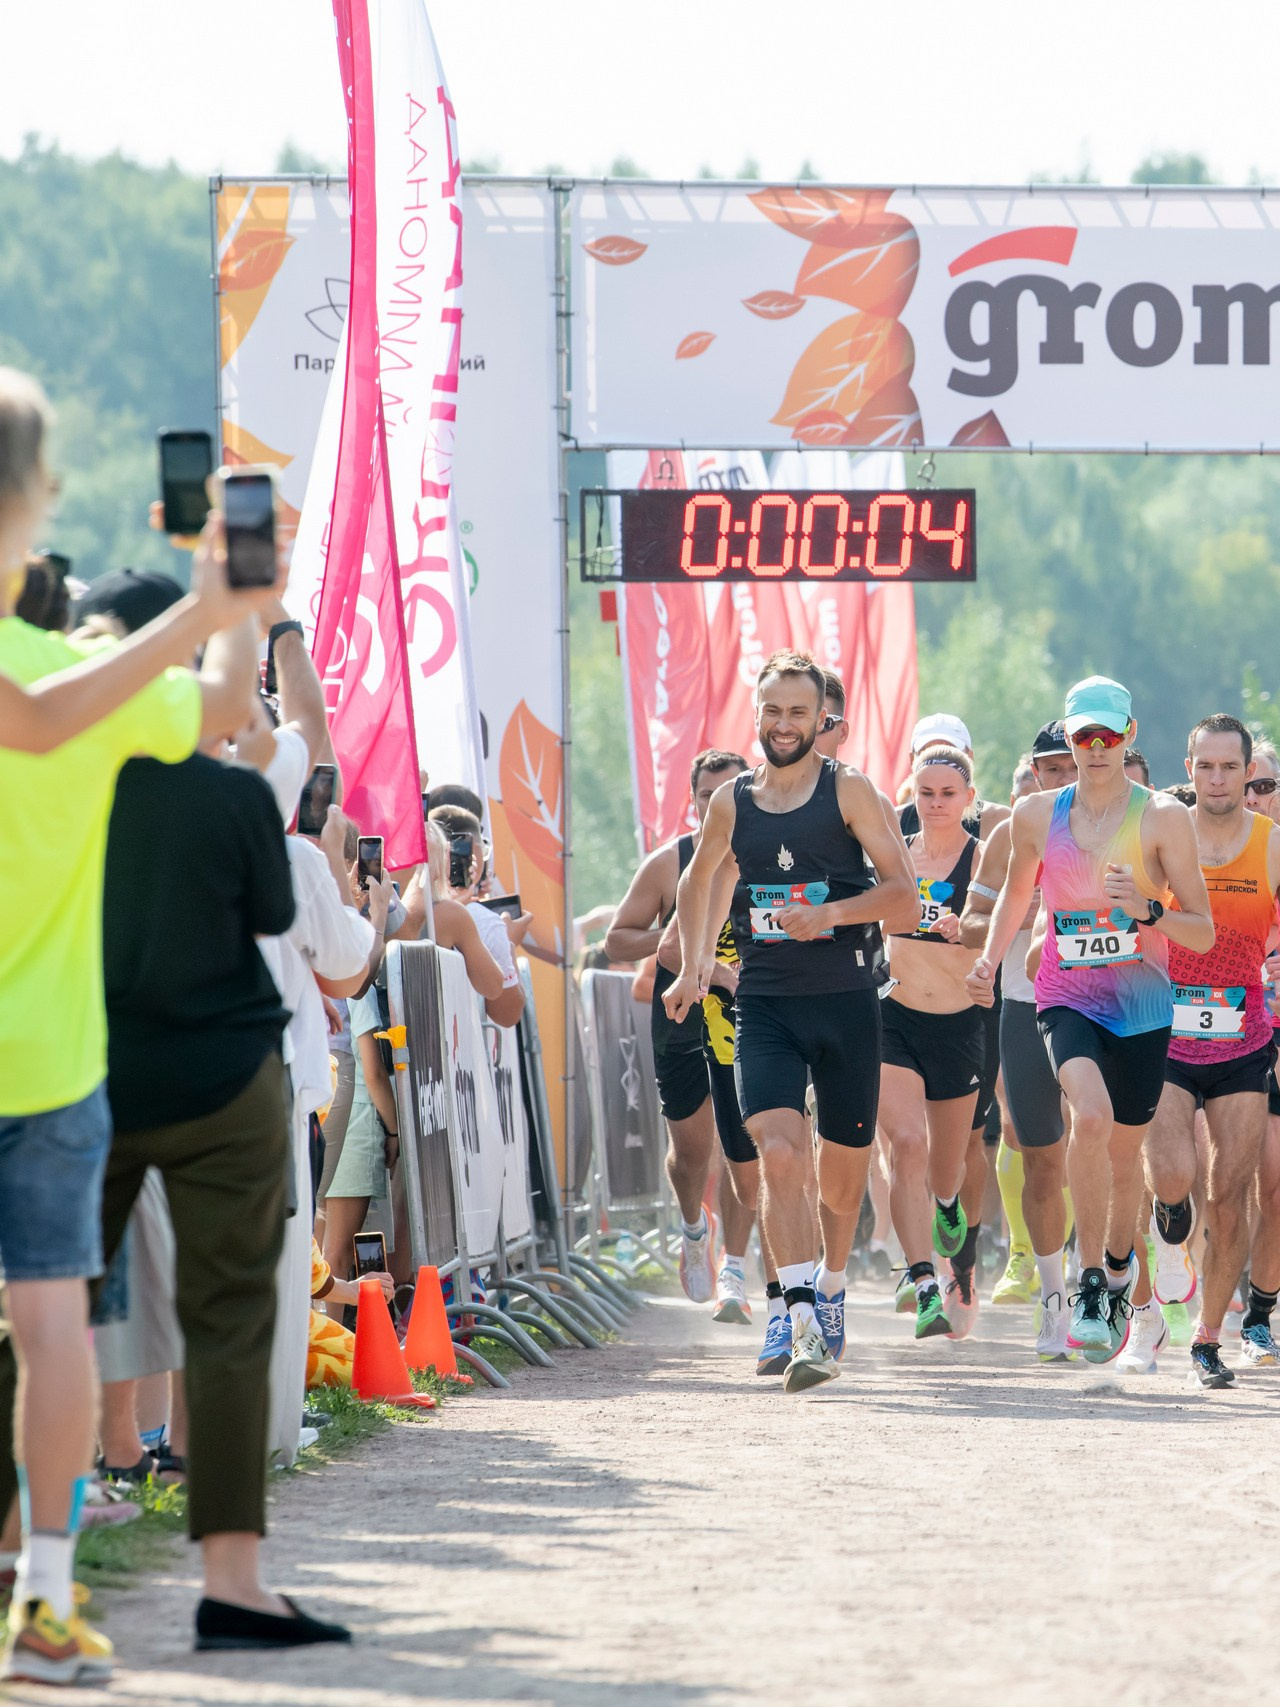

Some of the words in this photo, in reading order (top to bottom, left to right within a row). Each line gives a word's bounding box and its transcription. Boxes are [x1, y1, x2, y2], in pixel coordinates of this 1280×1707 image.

[294, 354, 335, 373] Пар
[680, 494, 966, 576] 0:00:04
[756, 889, 785, 901] grom
[1062, 918, 1091, 928] grom
[1075, 936, 1120, 957] 740
[1176, 988, 1205, 998] grom
[1200, 1011, 1213, 1029] 3
